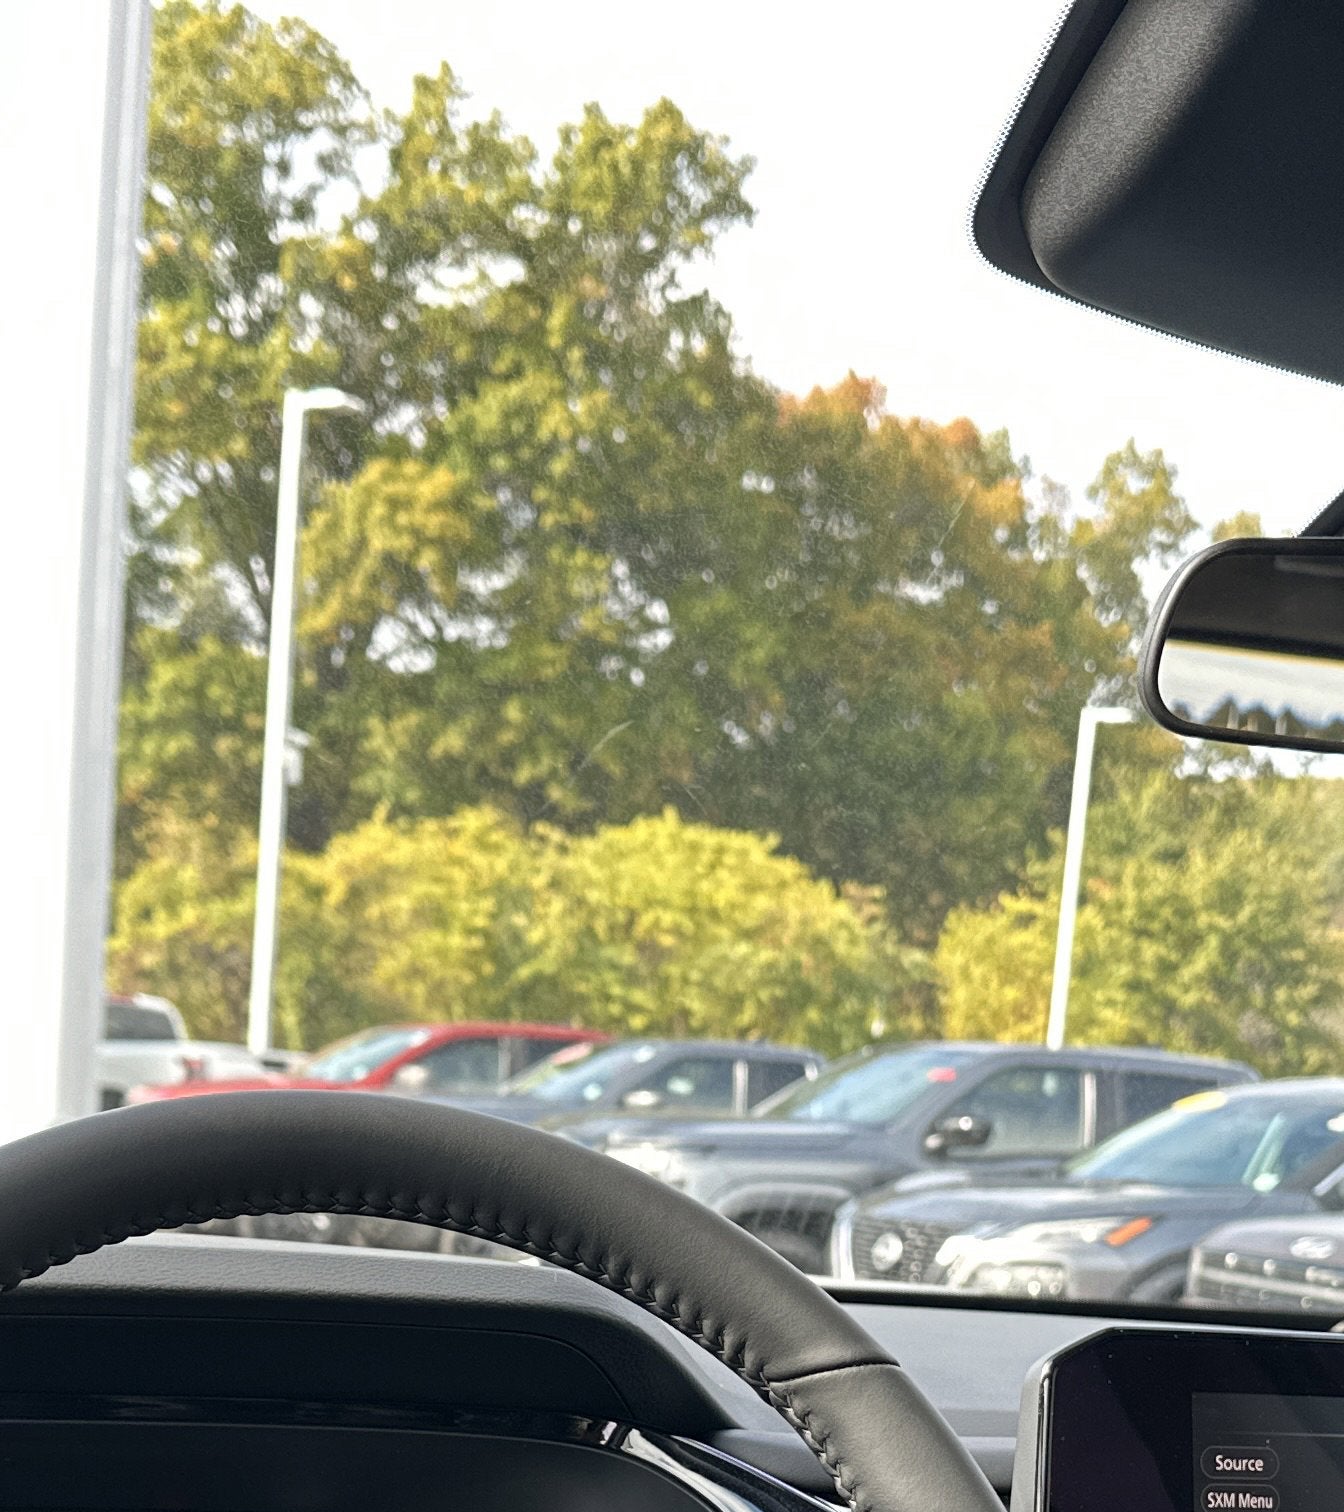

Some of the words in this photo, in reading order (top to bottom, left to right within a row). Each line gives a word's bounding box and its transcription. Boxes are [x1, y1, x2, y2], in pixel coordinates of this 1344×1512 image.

[1215, 1454, 1265, 1473] Source
[1207, 1491, 1235, 1509] SXM
[1238, 1492, 1273, 1509] Menu
